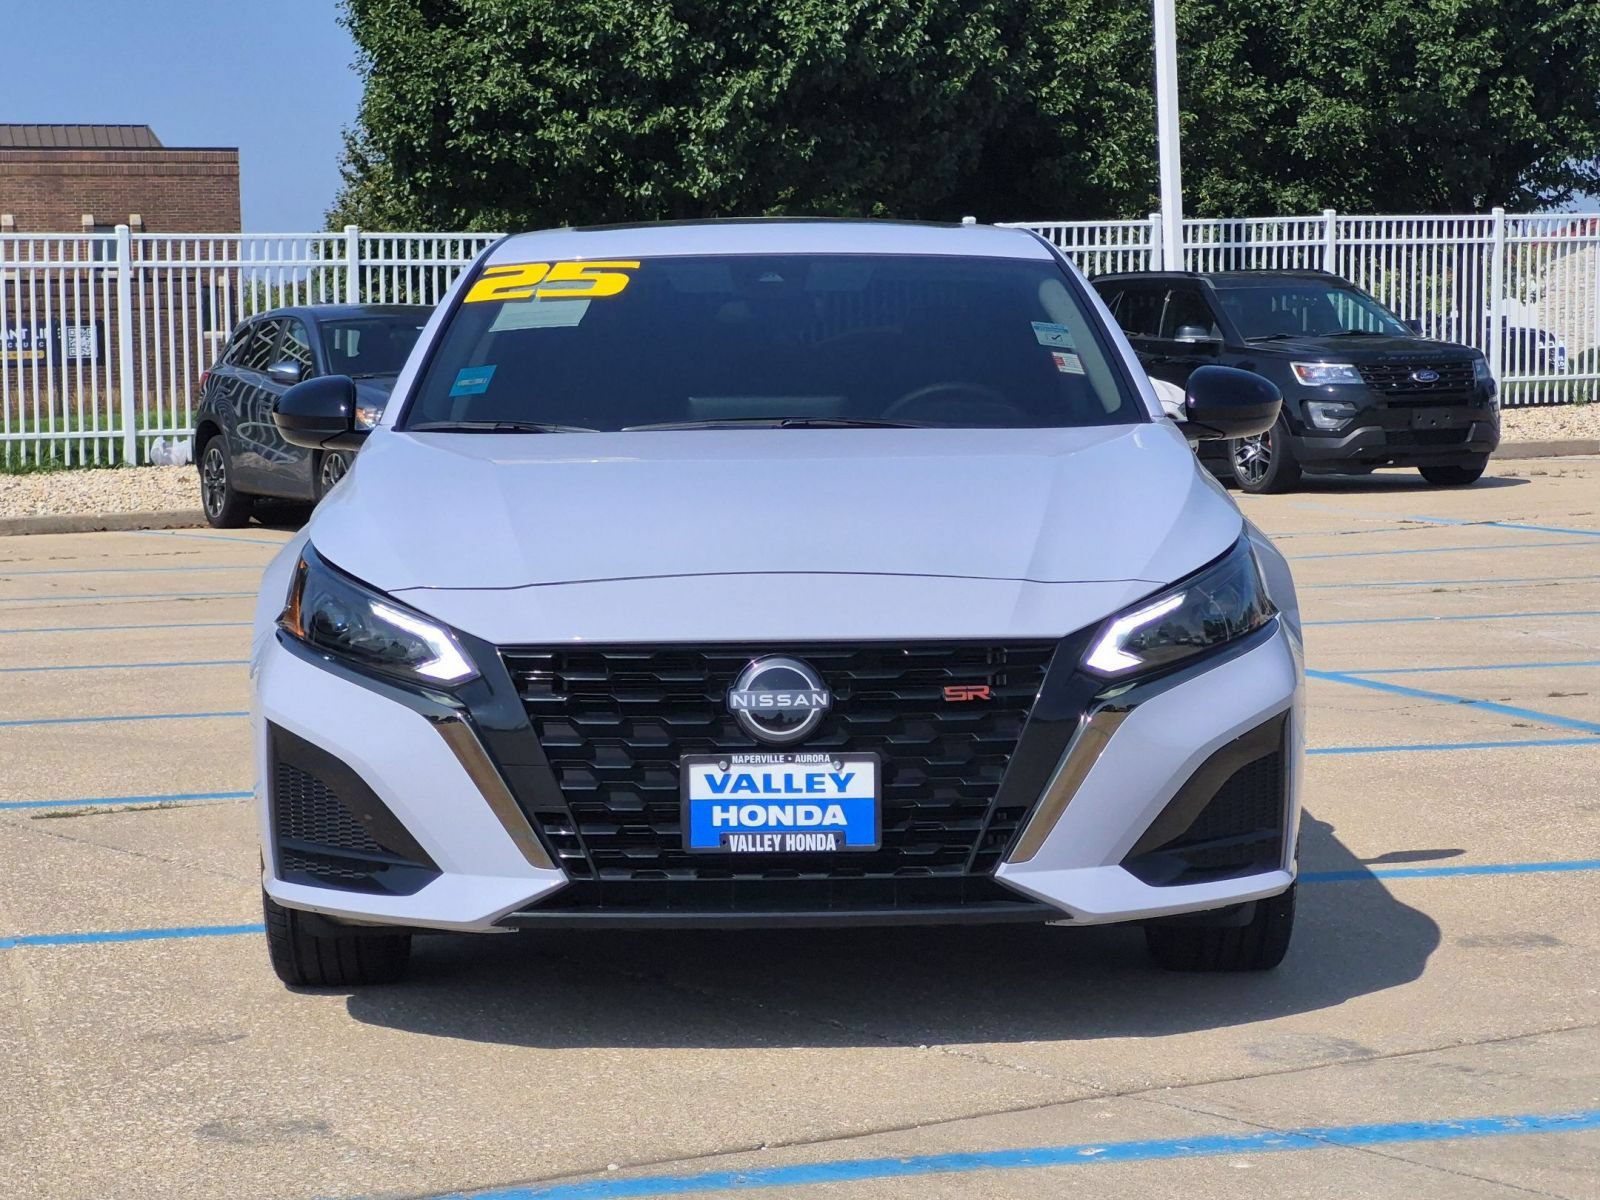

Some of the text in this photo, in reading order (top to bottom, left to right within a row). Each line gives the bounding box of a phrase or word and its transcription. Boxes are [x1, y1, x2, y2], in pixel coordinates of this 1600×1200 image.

[464, 261, 640, 303] 25
[732, 693, 828, 707] NISSAN
[943, 685, 991, 701] SR
[731, 754, 830, 764] NAPERVILLE AURORA
[703, 773, 856, 794] VALLEY
[712, 805, 848, 827] HONDA
[729, 833, 837, 852] VALLEY HONDA
